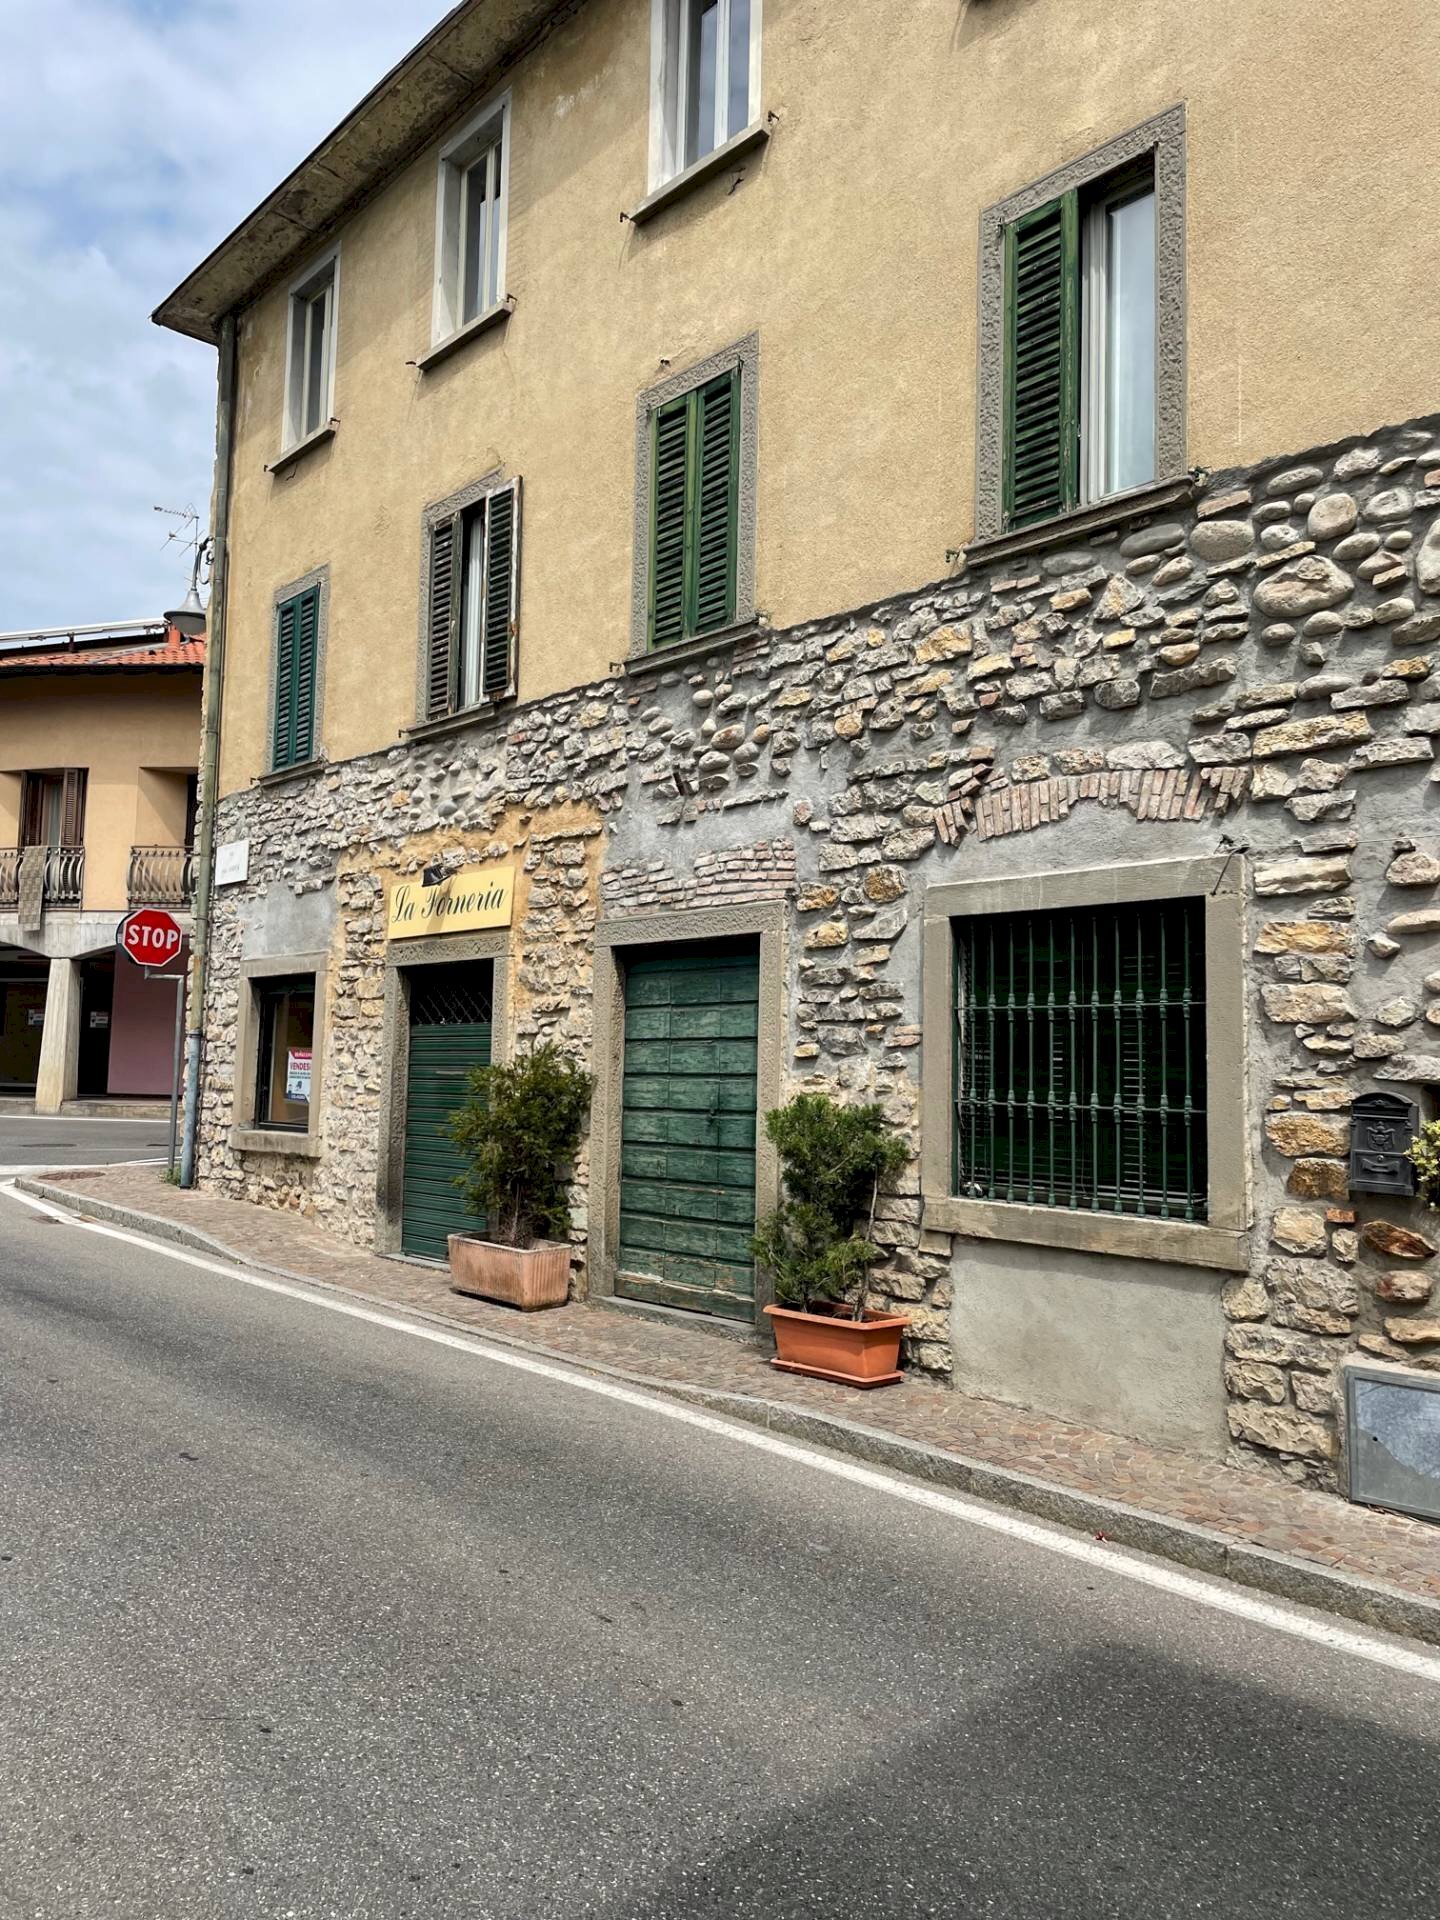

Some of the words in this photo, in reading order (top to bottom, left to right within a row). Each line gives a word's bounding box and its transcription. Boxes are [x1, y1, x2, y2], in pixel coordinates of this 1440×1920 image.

[392, 885, 415, 923] La
[421, 881, 505, 919] Forneria
[127, 924, 179, 950] STOP
[290, 1062, 311, 1071] VENDES
